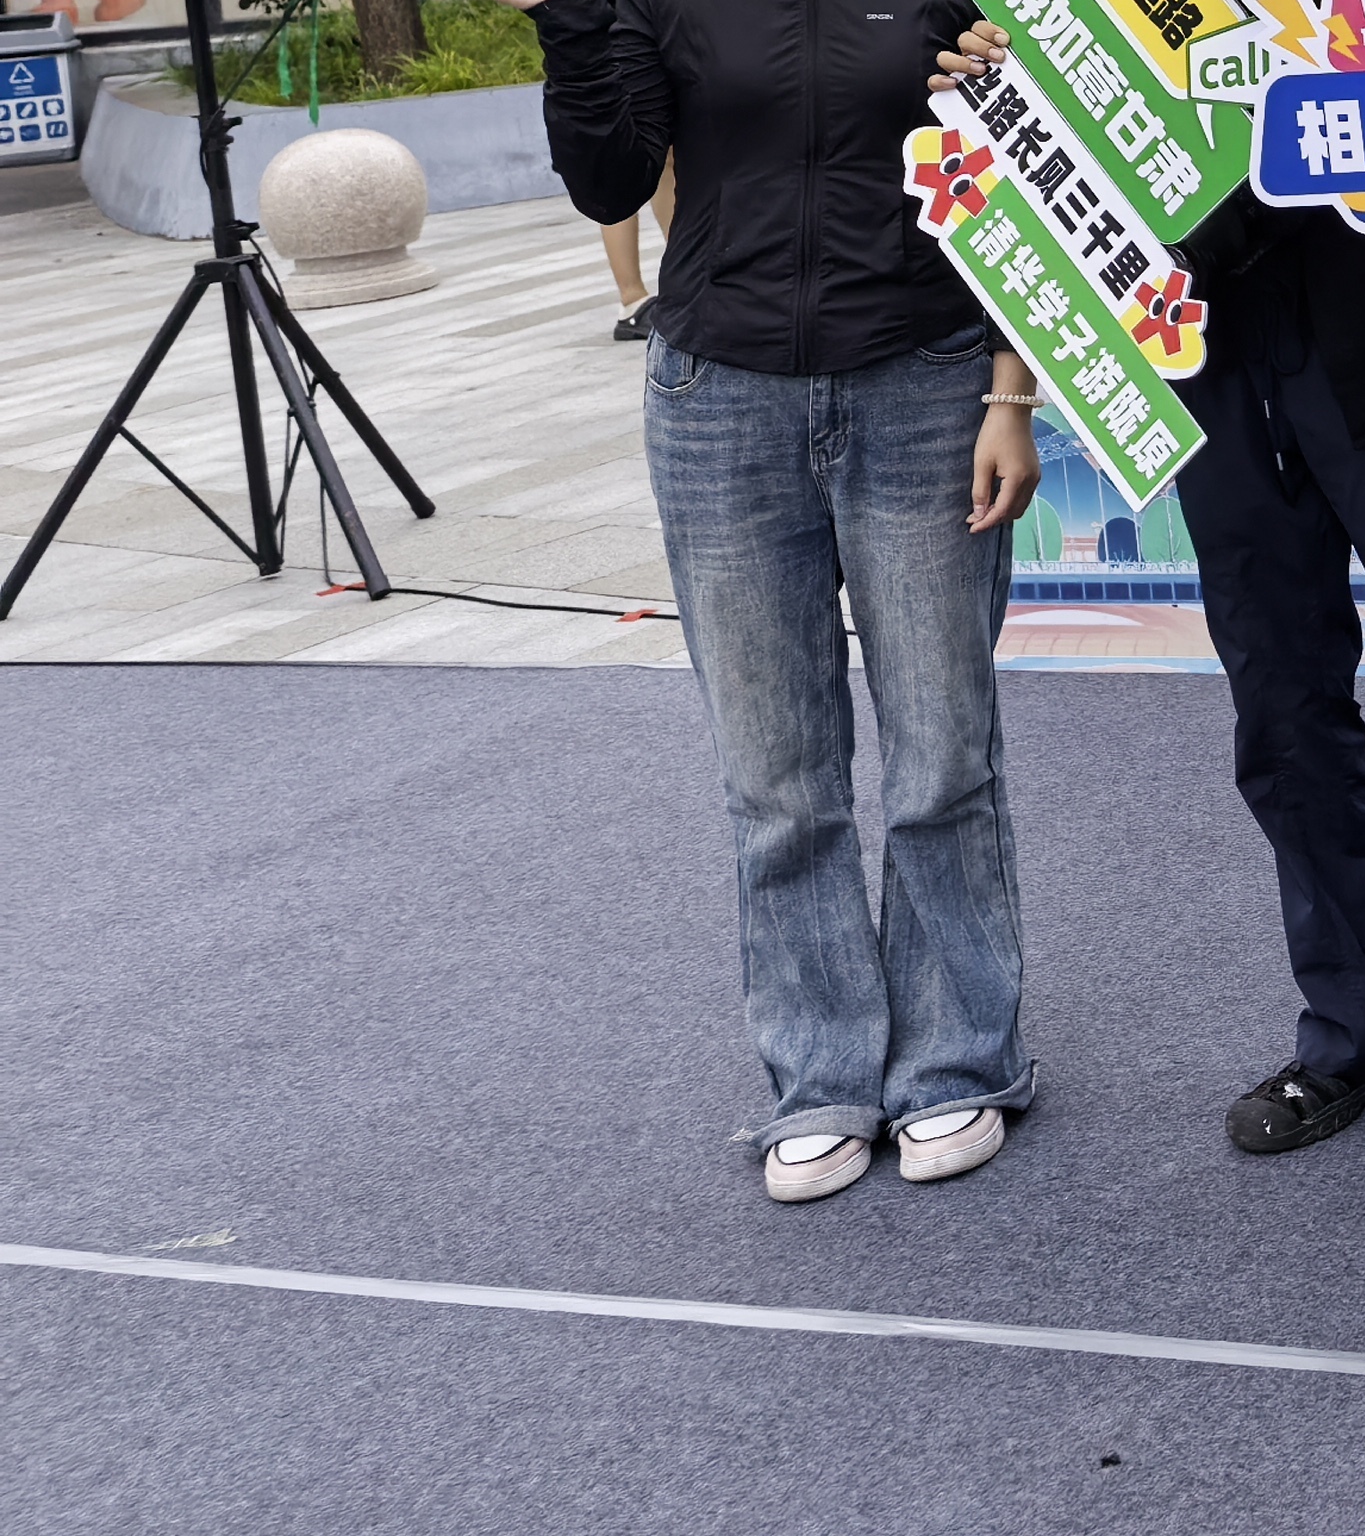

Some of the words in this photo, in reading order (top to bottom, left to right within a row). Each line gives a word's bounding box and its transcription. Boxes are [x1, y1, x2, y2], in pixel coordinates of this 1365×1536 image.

[956, 63, 1151, 302] 丝路长风三千里
[967, 207, 1182, 482] 清华学子游陇原
